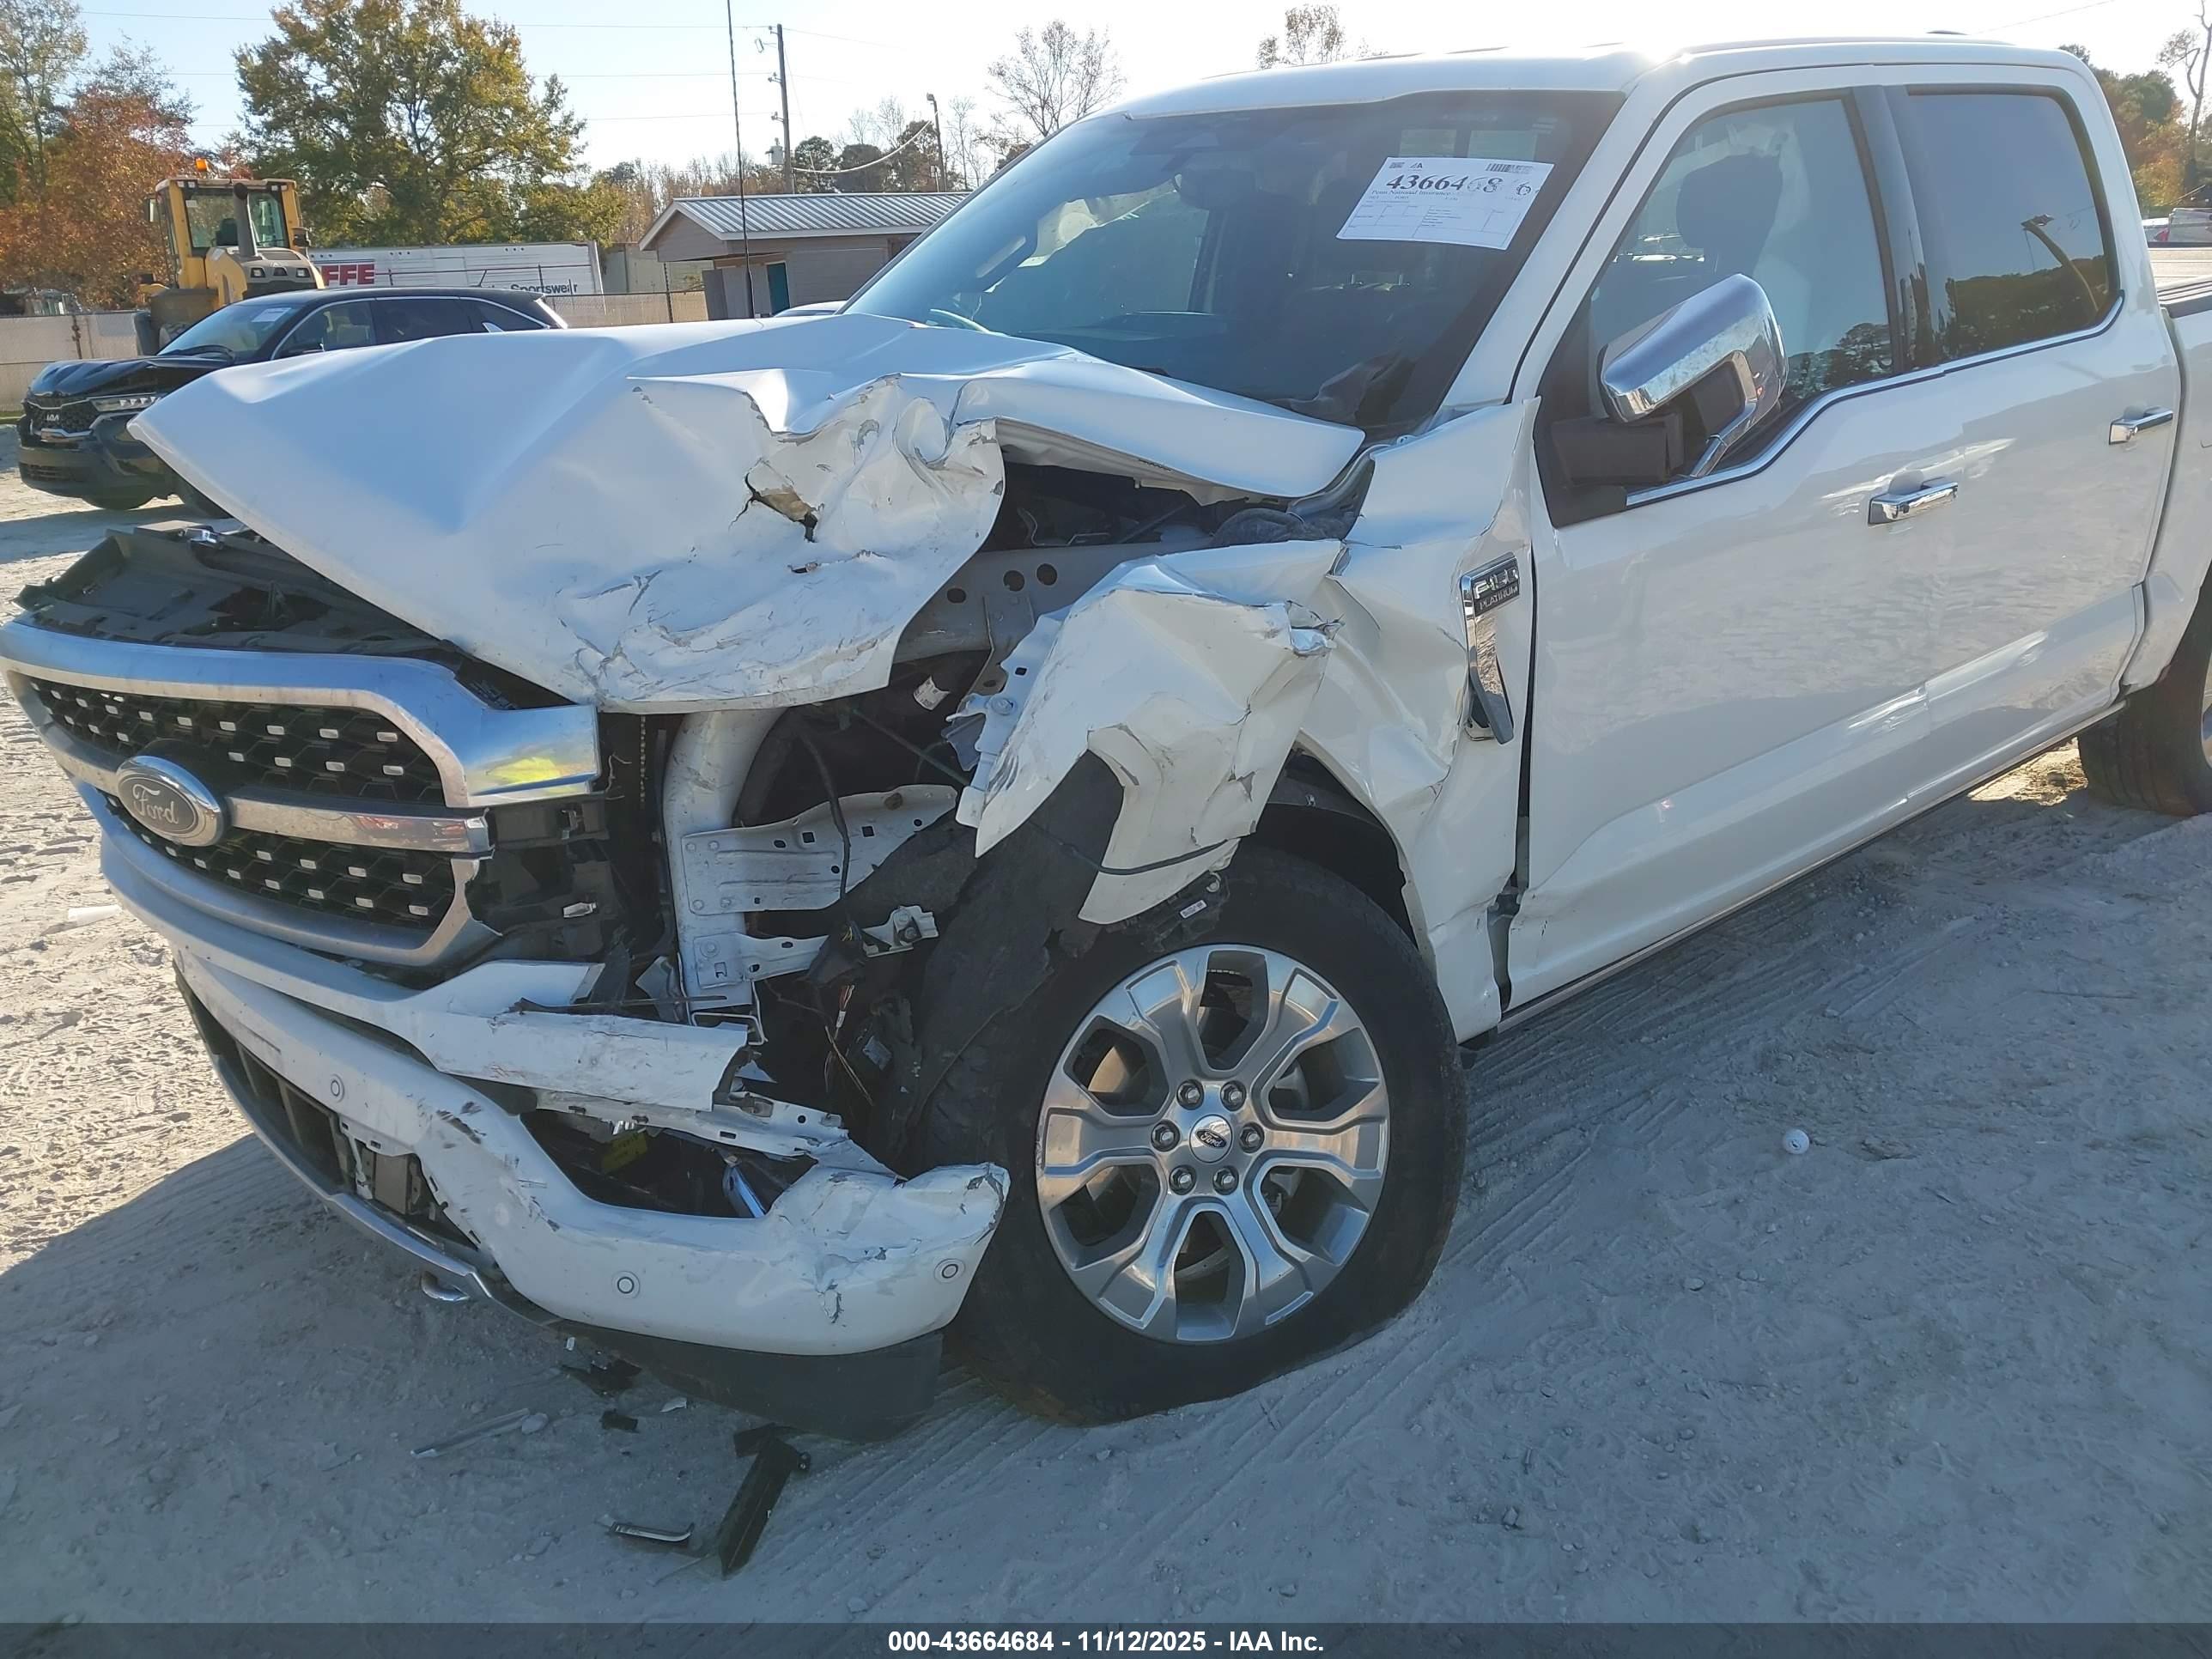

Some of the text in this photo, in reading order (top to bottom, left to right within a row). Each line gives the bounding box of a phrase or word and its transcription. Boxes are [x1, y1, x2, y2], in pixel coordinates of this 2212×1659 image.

[1479, 585, 1518, 611] PLATINUM
[132, 783, 179, 824] Ford
[1200, 1131, 1224, 1147] Ford
